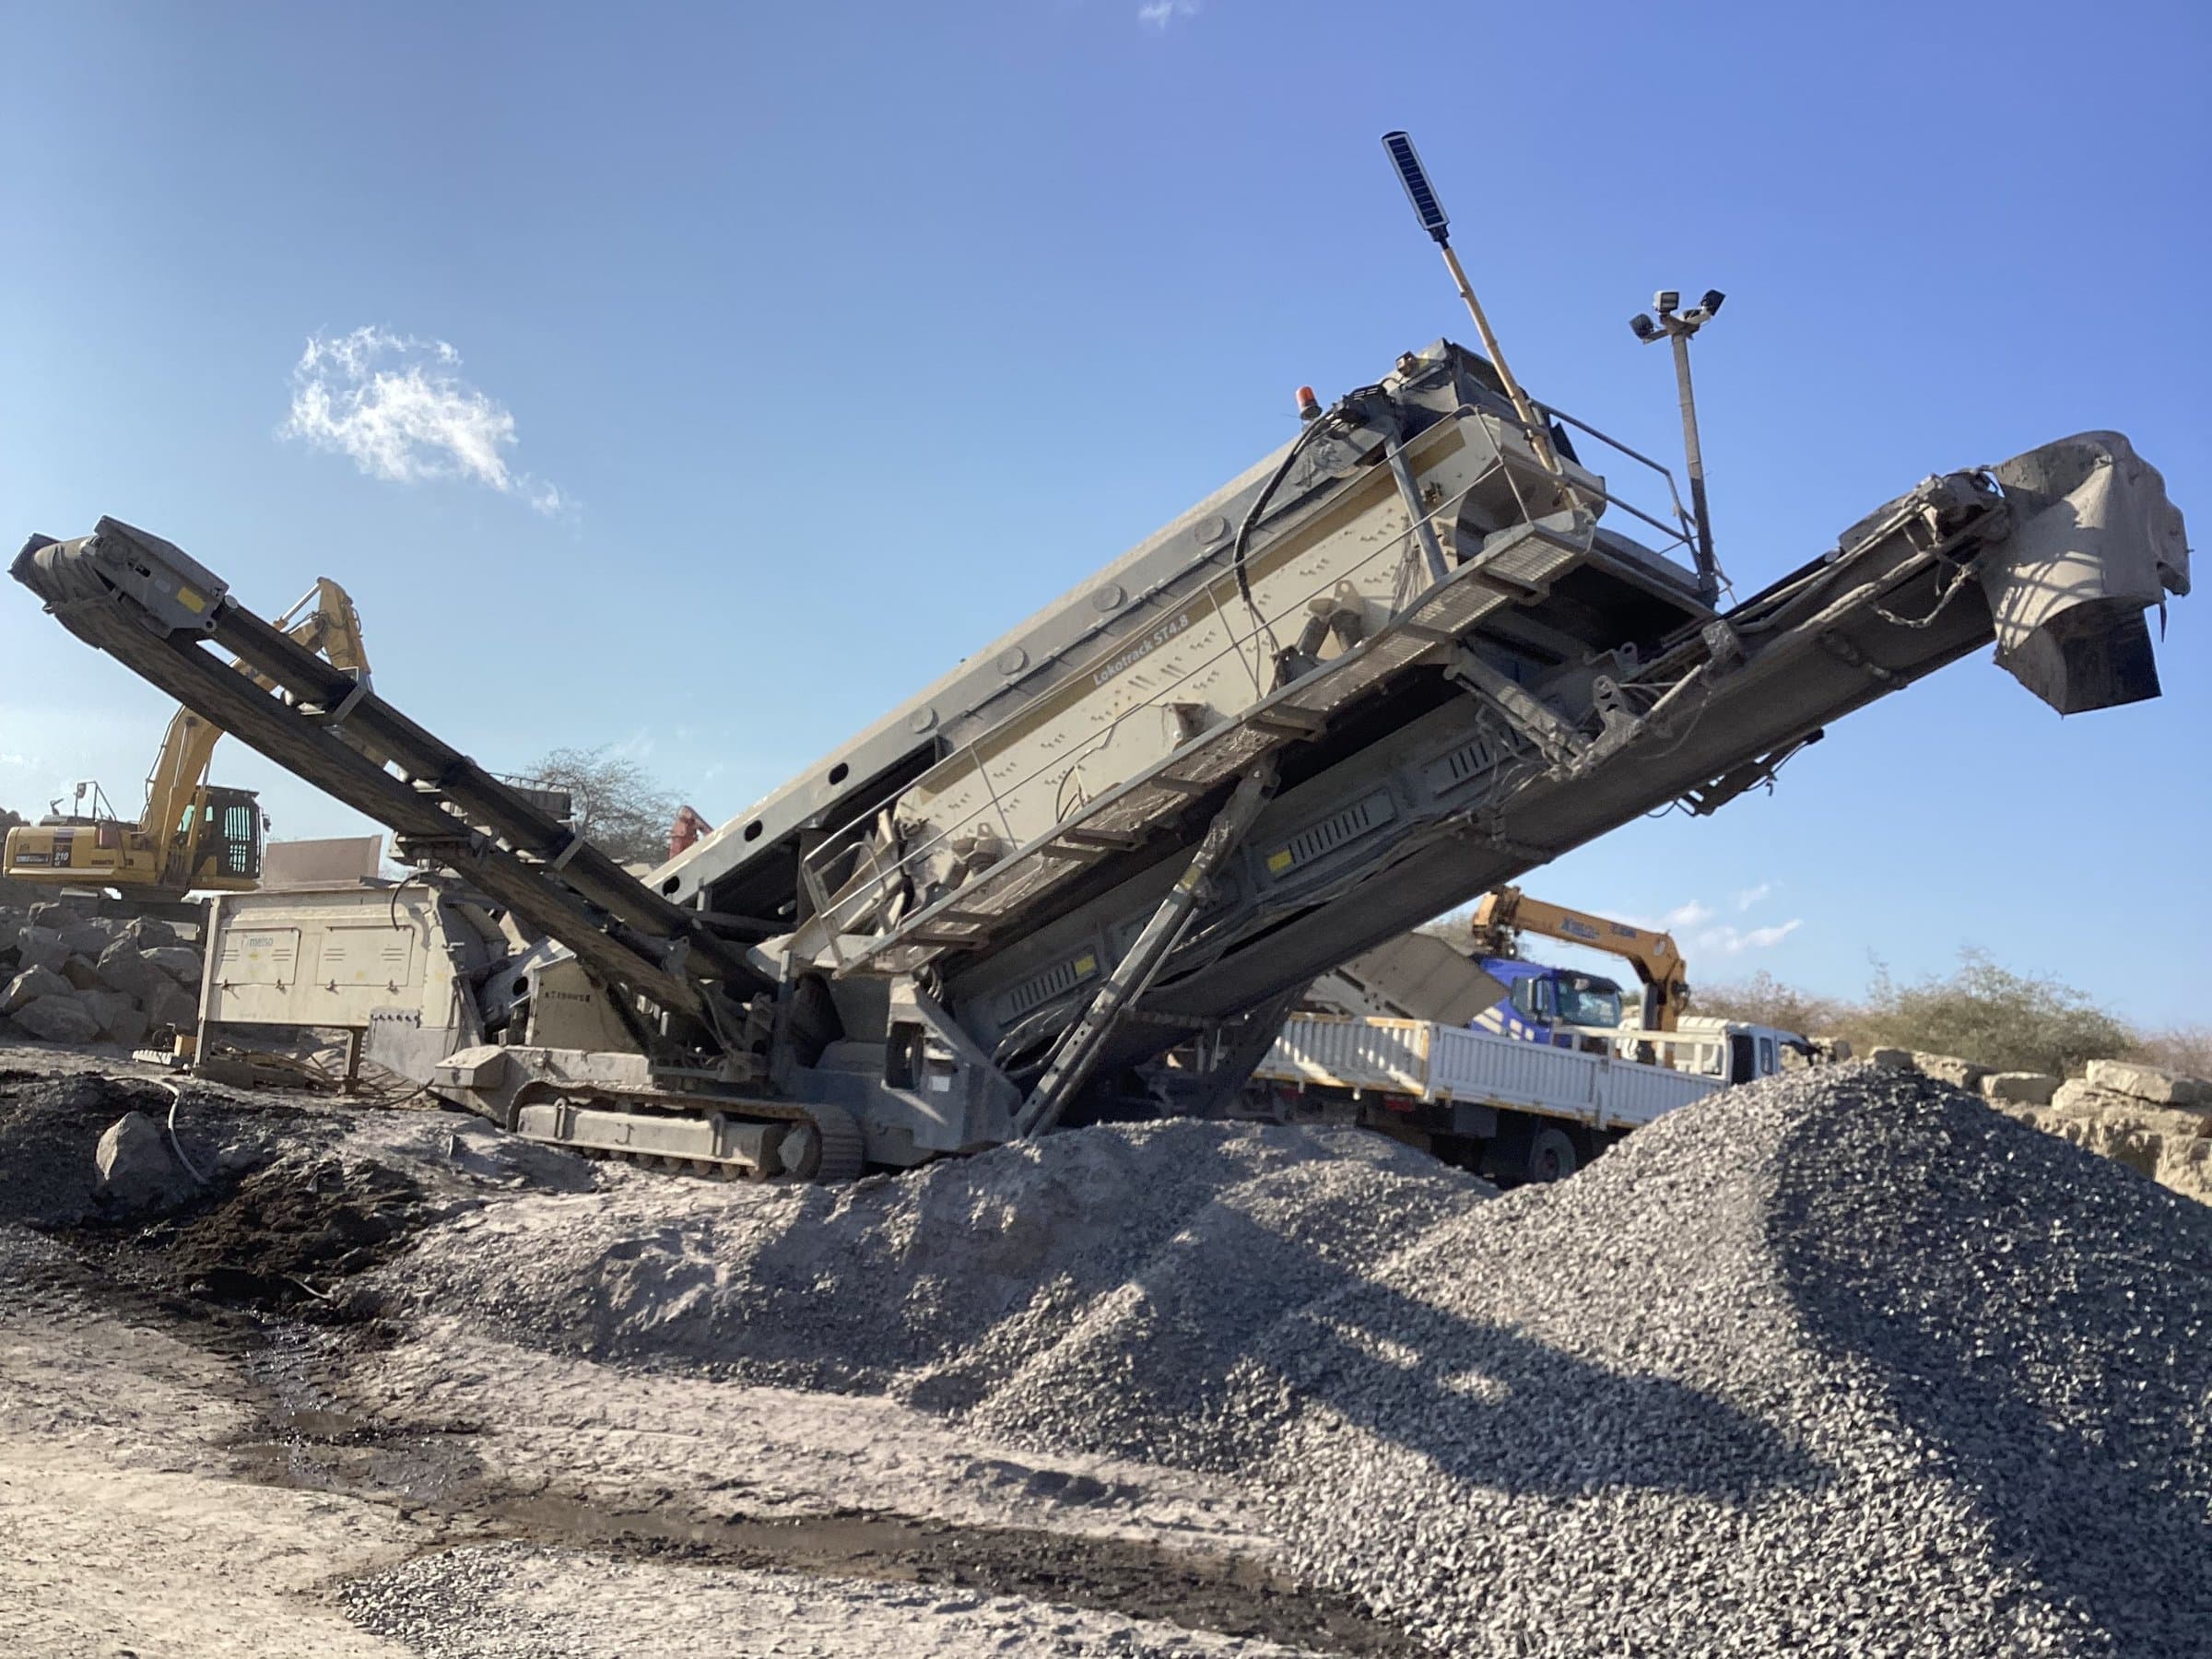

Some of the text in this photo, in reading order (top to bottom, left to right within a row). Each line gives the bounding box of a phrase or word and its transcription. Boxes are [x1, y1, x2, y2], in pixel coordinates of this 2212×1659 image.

[1093, 615, 1189, 686] Lokotrack ST4.8
[54, 851, 69, 862] 210
